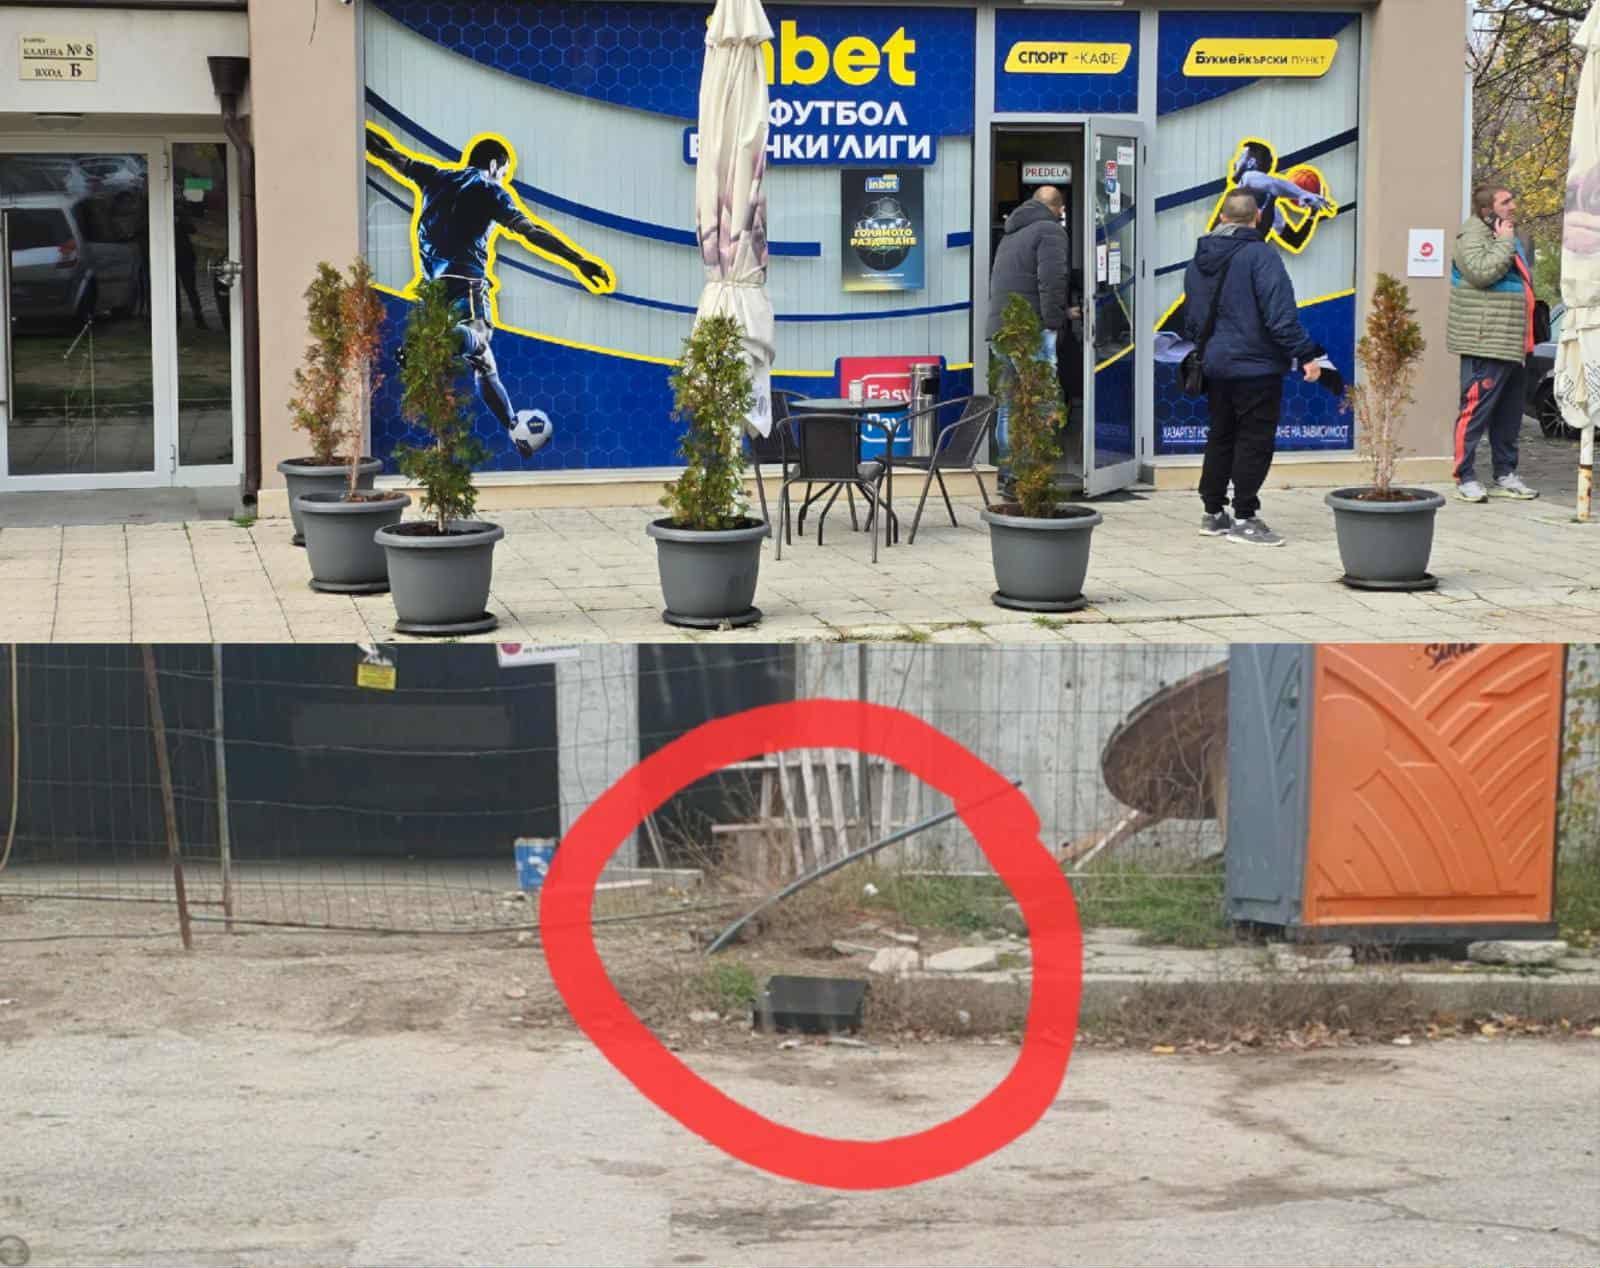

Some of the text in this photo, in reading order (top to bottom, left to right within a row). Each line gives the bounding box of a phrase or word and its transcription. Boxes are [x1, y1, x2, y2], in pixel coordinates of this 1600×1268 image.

[85, 44, 94, 56] 8
[706, 15, 916, 86] bet
[1018, 51, 1068, 64] СПОРТ
[34, 63, 82, 77] ВХОД Б
[768, 98, 908, 127] ФУТБОЛ
[689, 134, 828, 159] ЧКИ
[1025, 167, 1069, 177] PREDELA
[868, 180, 897, 189] inbet
[867, 384, 912, 404] Easy
